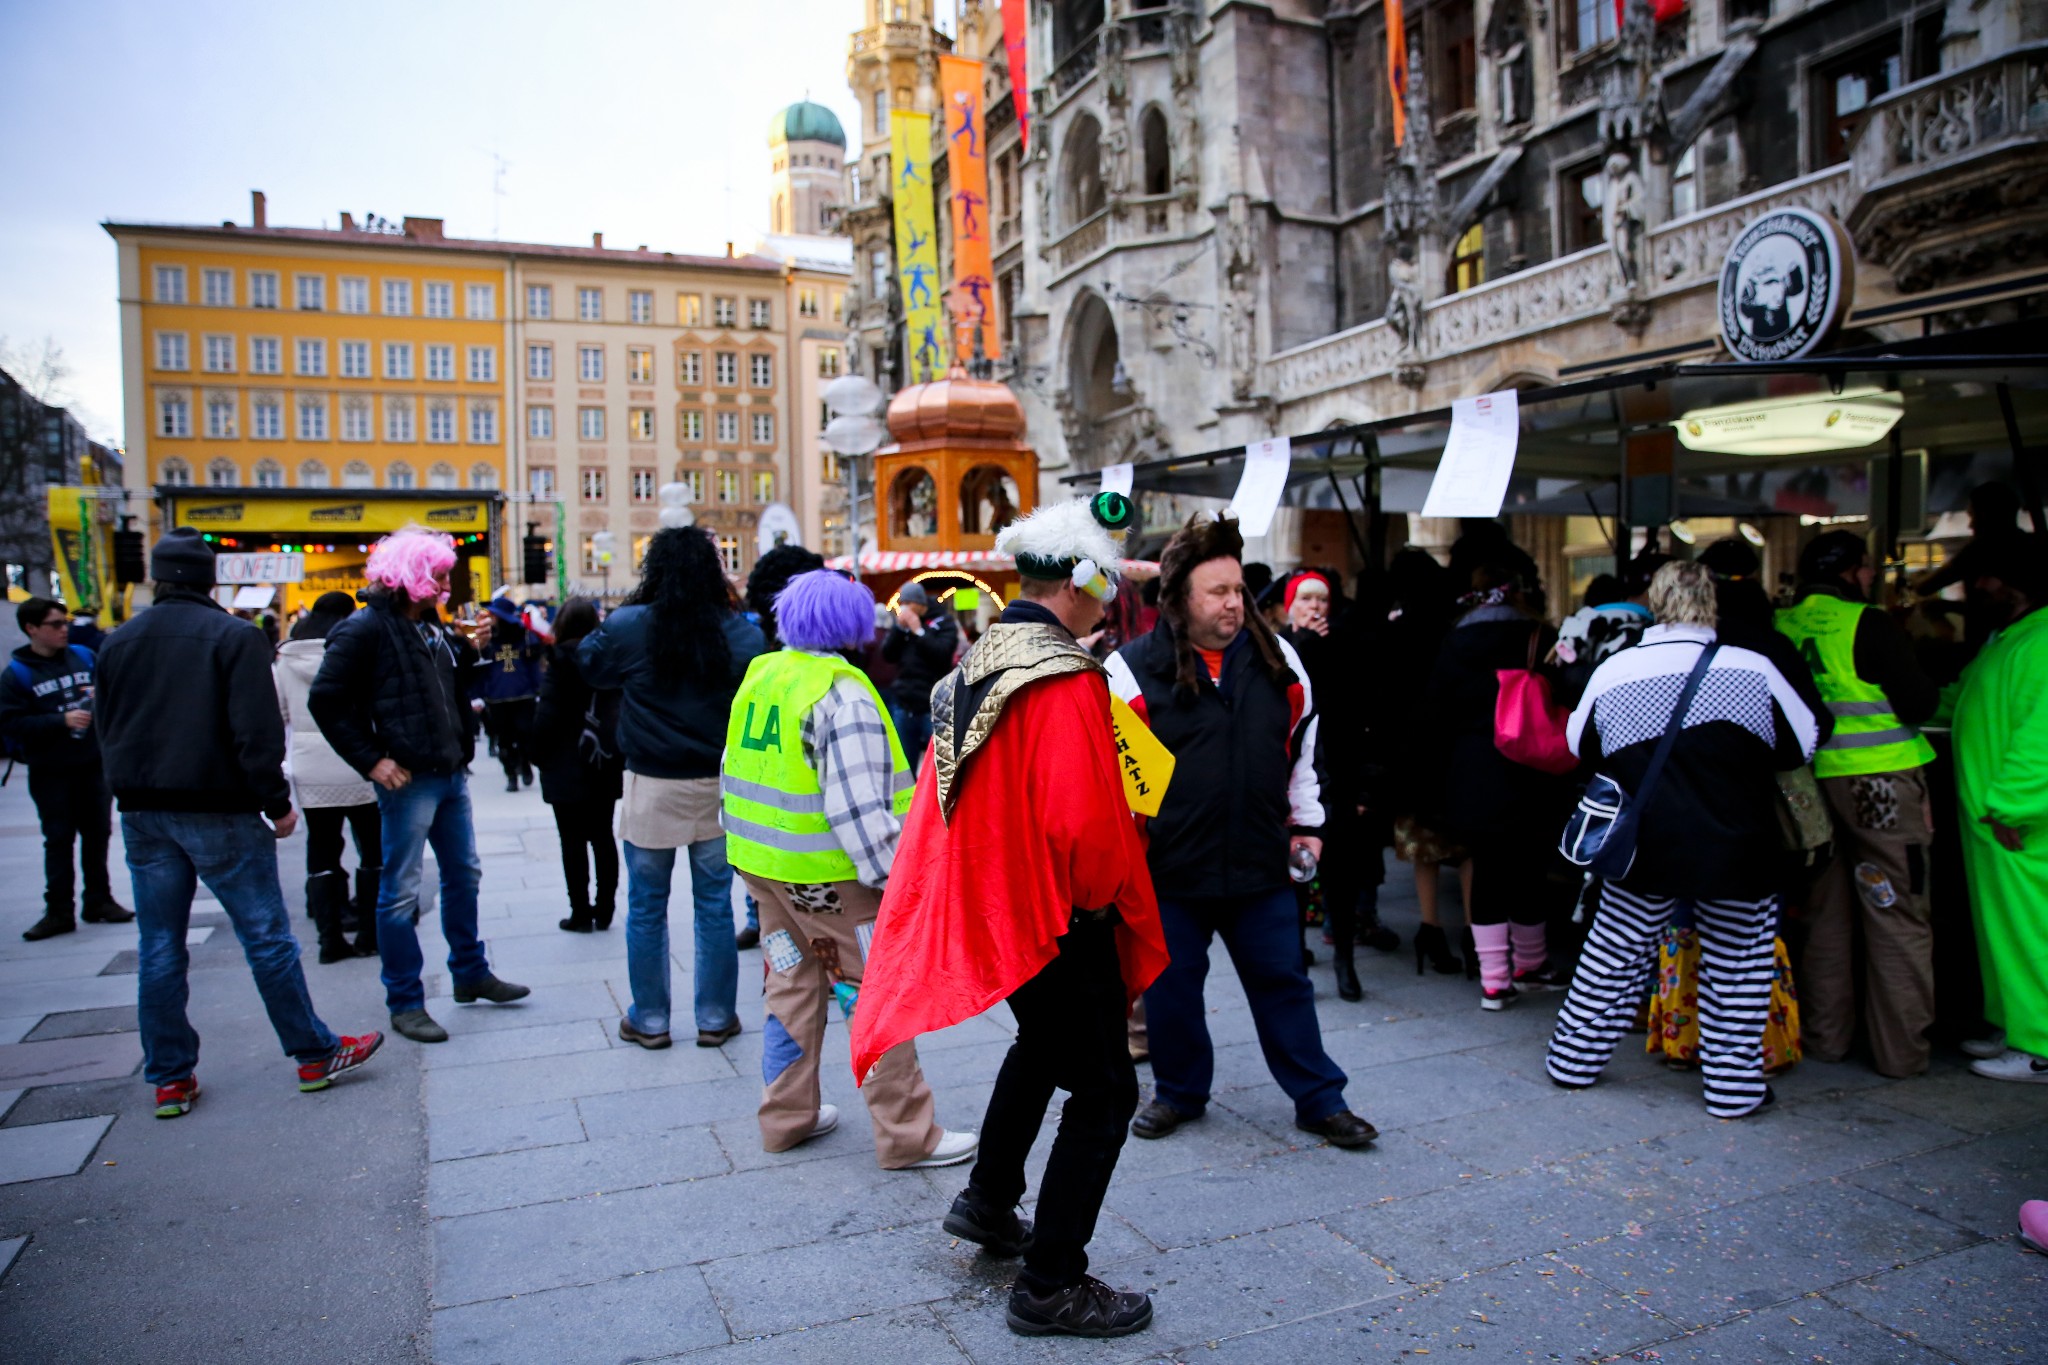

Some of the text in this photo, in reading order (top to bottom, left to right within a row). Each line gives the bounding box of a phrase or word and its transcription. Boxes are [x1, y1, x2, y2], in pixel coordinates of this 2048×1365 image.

[219, 554, 299, 581] KONFETTI
[1799, 636, 1828, 675] A
[740, 701, 782, 754] LA
[1111, 713, 1150, 797] CHATZ
